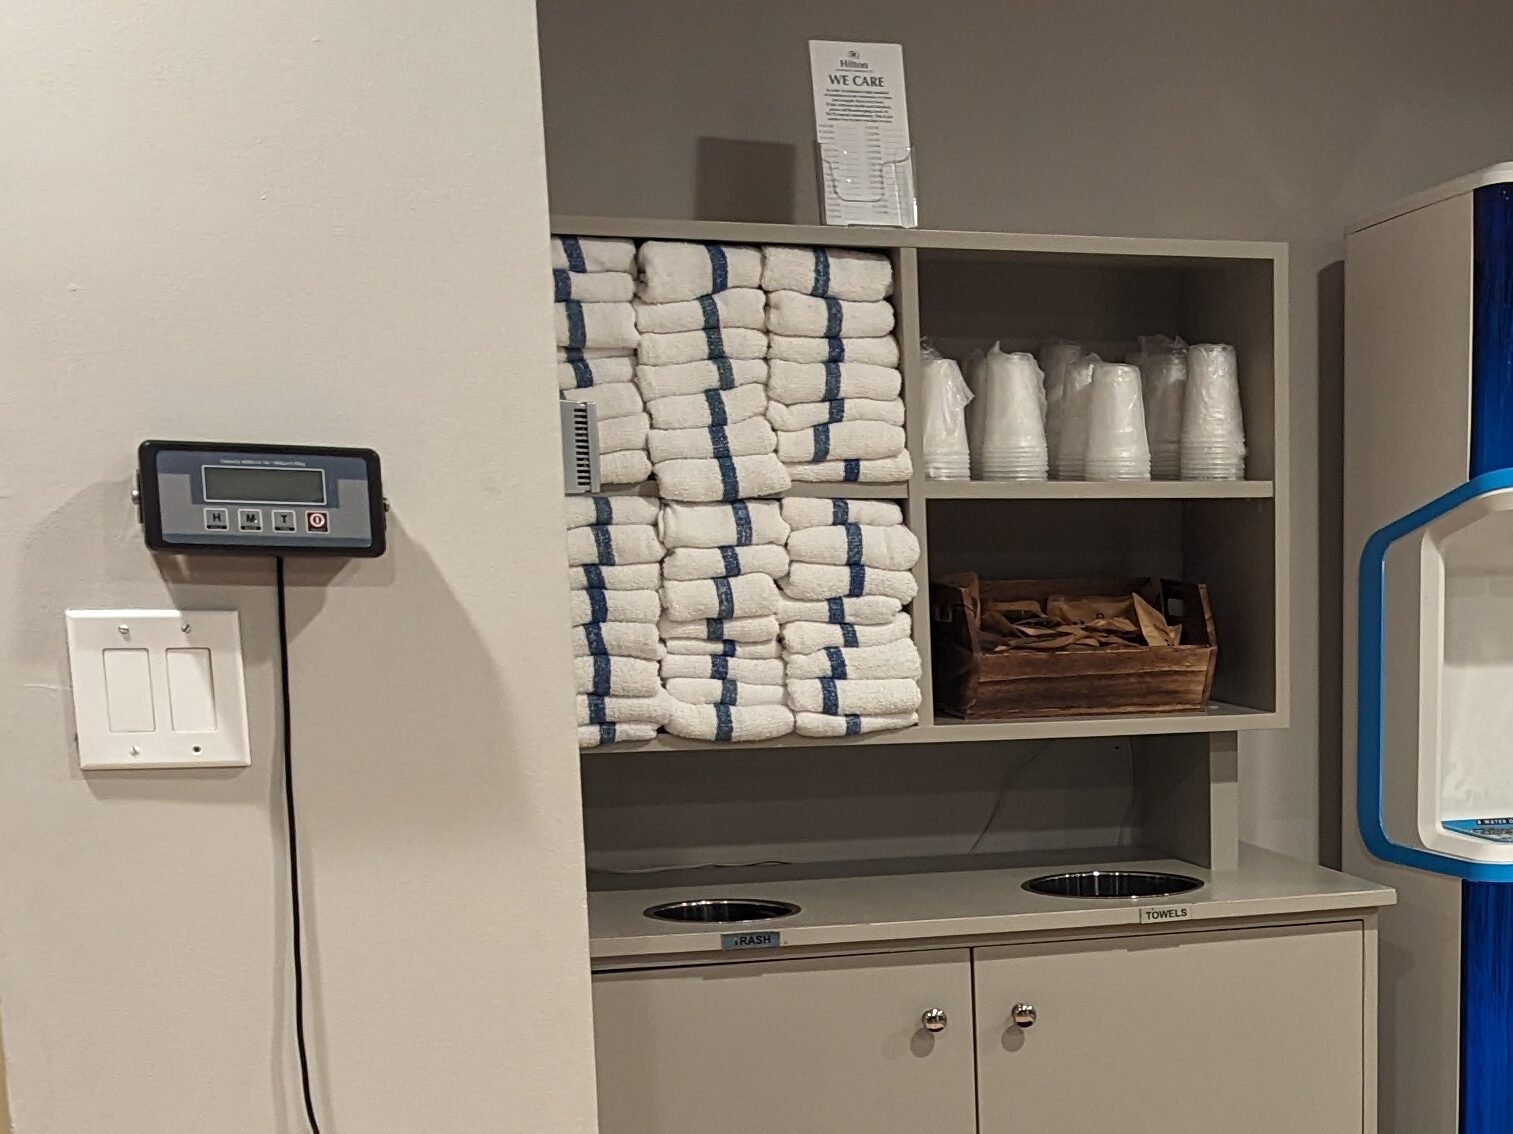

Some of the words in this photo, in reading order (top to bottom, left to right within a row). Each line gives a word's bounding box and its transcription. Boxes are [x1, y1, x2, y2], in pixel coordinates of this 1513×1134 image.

[828, 74, 850, 86] WE
[852, 75, 885, 88] CARE
[212, 513, 221, 523] H
[280, 514, 288, 524] T
[1483, 818, 1508, 826] WATER
[1145, 908, 1188, 920] TOWELS
